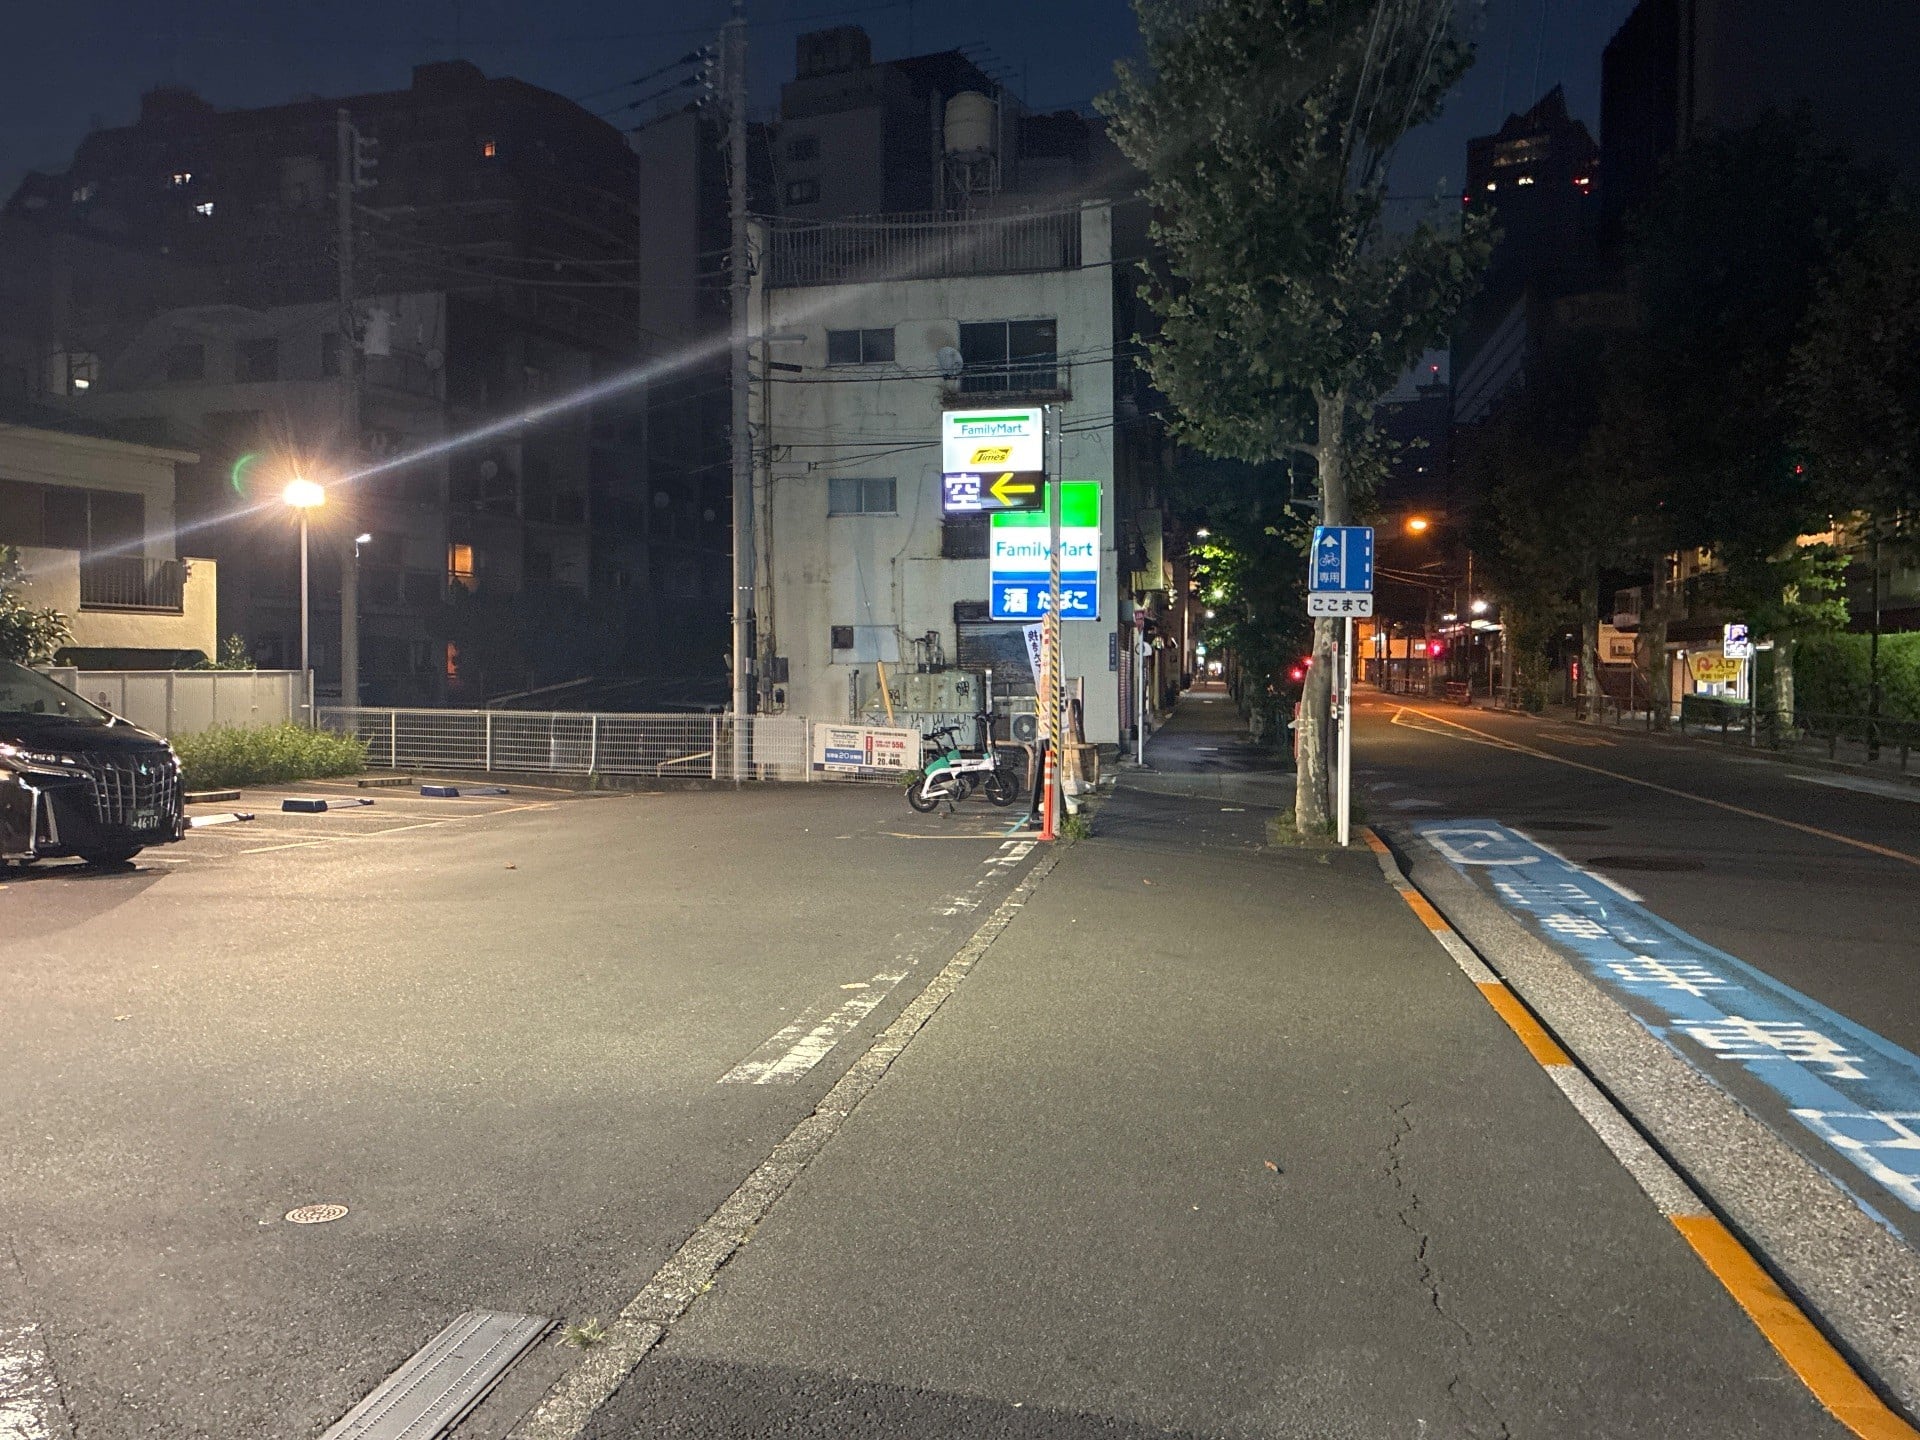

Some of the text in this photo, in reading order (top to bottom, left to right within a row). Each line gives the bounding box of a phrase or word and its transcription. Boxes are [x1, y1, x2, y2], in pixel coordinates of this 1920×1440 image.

[962, 423, 1021, 435] FamilyMart
[977, 449, 1010, 462] Times
[945, 473, 982, 509] 空
[1003, 588, 1089, 613] 酒 たばこ
[1313, 598, 1369, 612] ここまで
